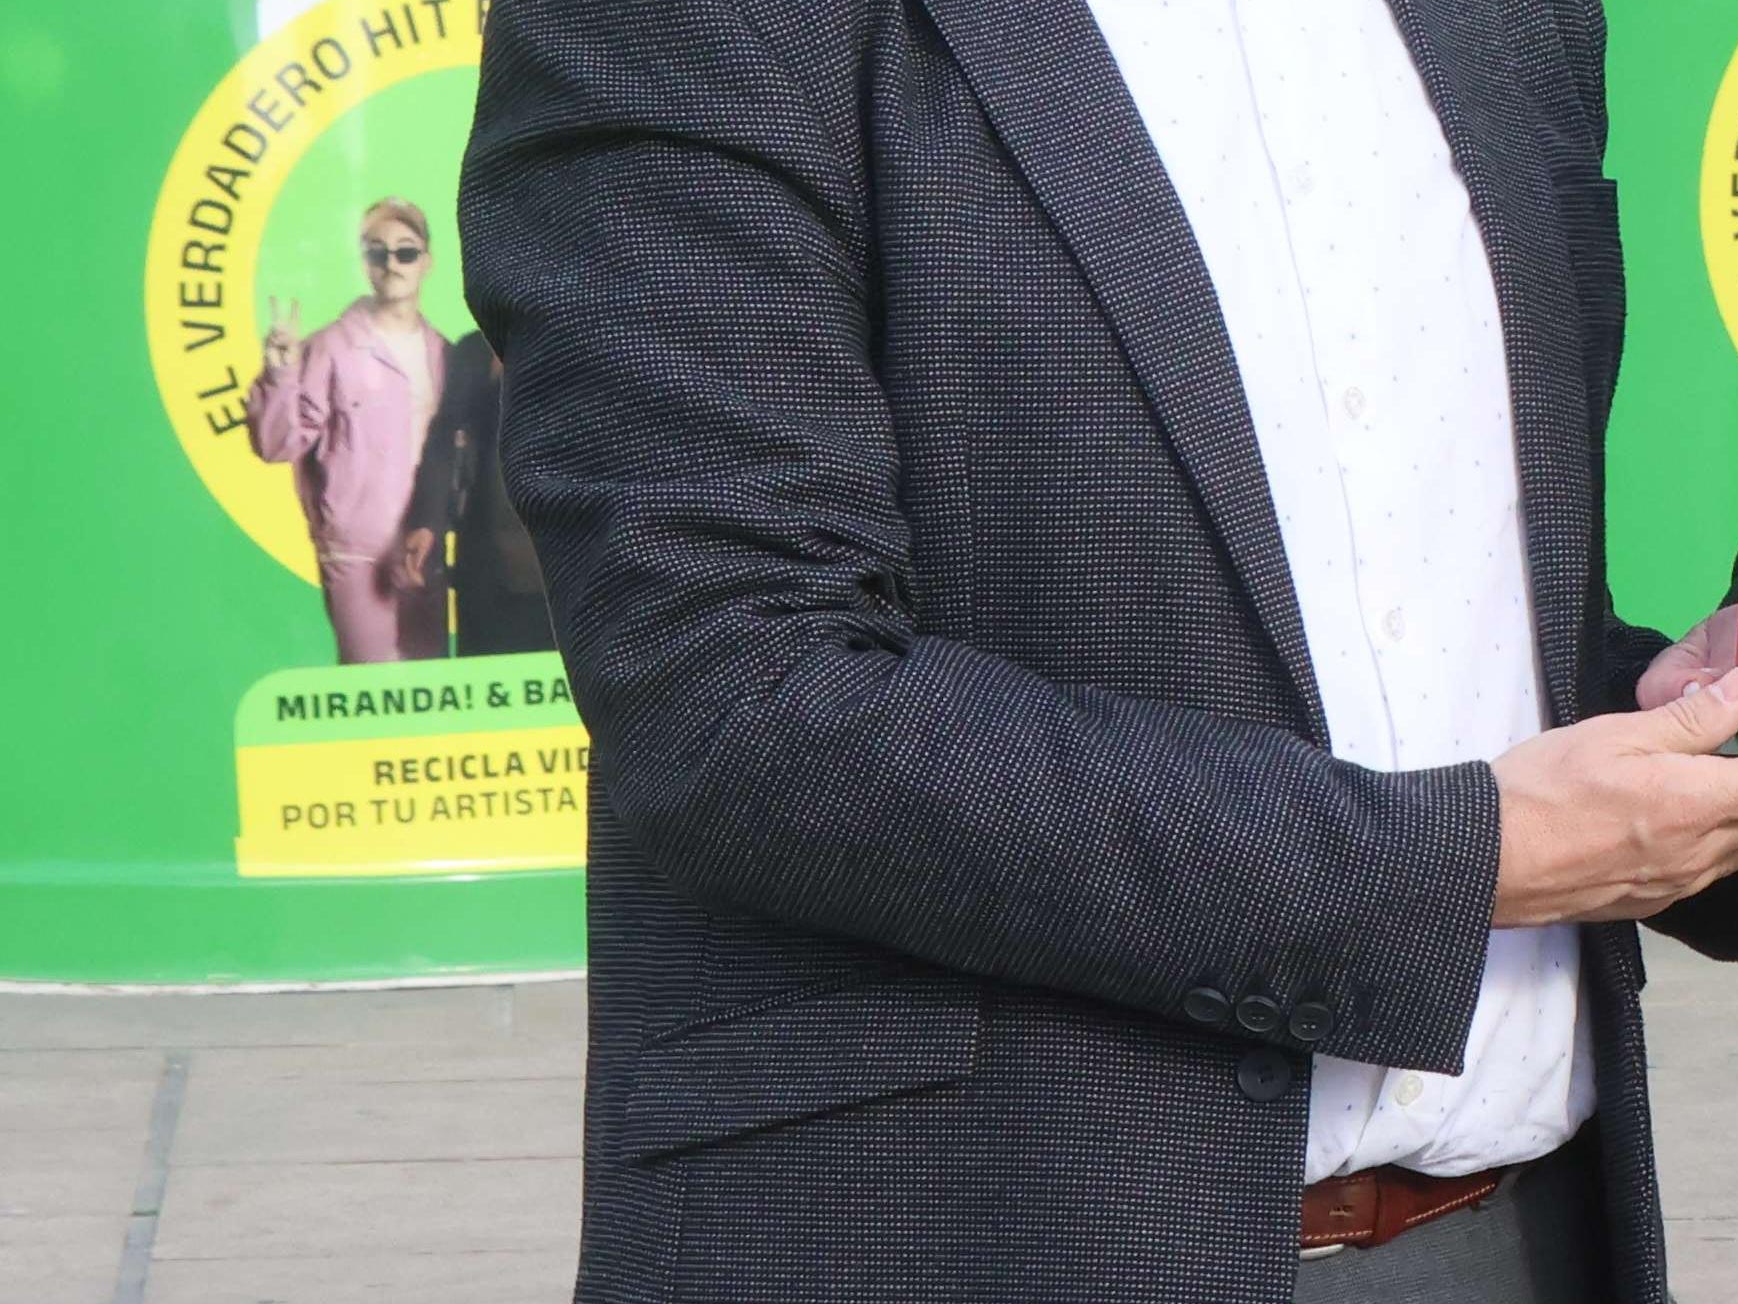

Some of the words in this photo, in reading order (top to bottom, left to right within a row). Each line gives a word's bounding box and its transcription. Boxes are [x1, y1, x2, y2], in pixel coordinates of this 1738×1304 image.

[179, 36, 352, 353] VERDADERO
[198, 365, 248, 436] EL
[277, 683, 472, 722] MIRANDA!
[487, 681, 511, 708] &
[372, 751, 525, 786] RECICLA
[281, 801, 357, 831] POR
[369, 797, 416, 826] TU
[429, 786, 579, 822] ARTISTA
